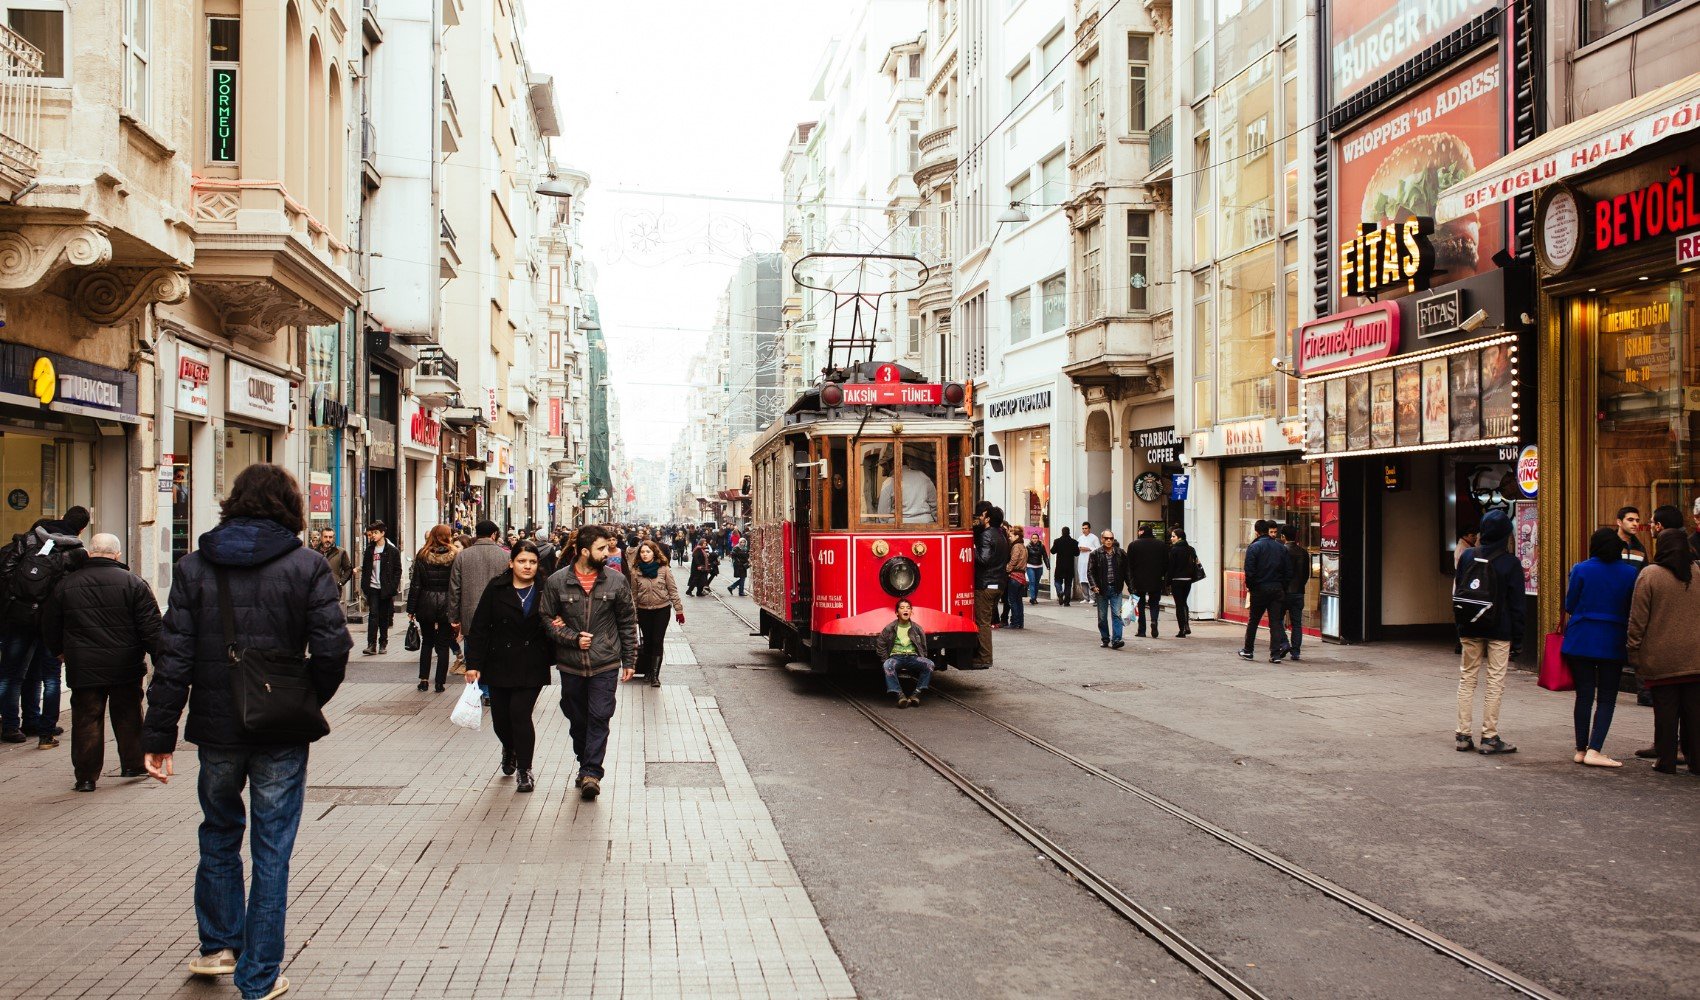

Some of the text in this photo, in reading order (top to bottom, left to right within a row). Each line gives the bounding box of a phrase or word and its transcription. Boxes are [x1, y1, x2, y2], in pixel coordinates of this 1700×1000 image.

[1341, 0, 1484, 88] BURGER KIN
[219, 73, 231, 160] DORMEUIL
[1571, 129, 1636, 168] HALK
[1653, 103, 1700, 137] DÖ
[1341, 215, 1421, 298] FİTAŞ
[1419, 301, 1457, 329] FİTAŞ
[1608, 301, 1670, 333] MEHMET DOĞAN
[883, 366, 892, 382] 3
[1625, 365, 1650, 383] No: 10
[58, 373, 121, 408] TURKCELL
[248, 376, 276, 405] CLINIQUE
[901, 387, 934, 403] TÜNEL
[989, 397, 1018, 418] TOPSHOP
[1017, 390, 1051, 413] TOPMAN
[1147, 447, 1174, 464] COFFEE
[818, 549, 835, 565] 410
[959, 547, 973, 563] 410
